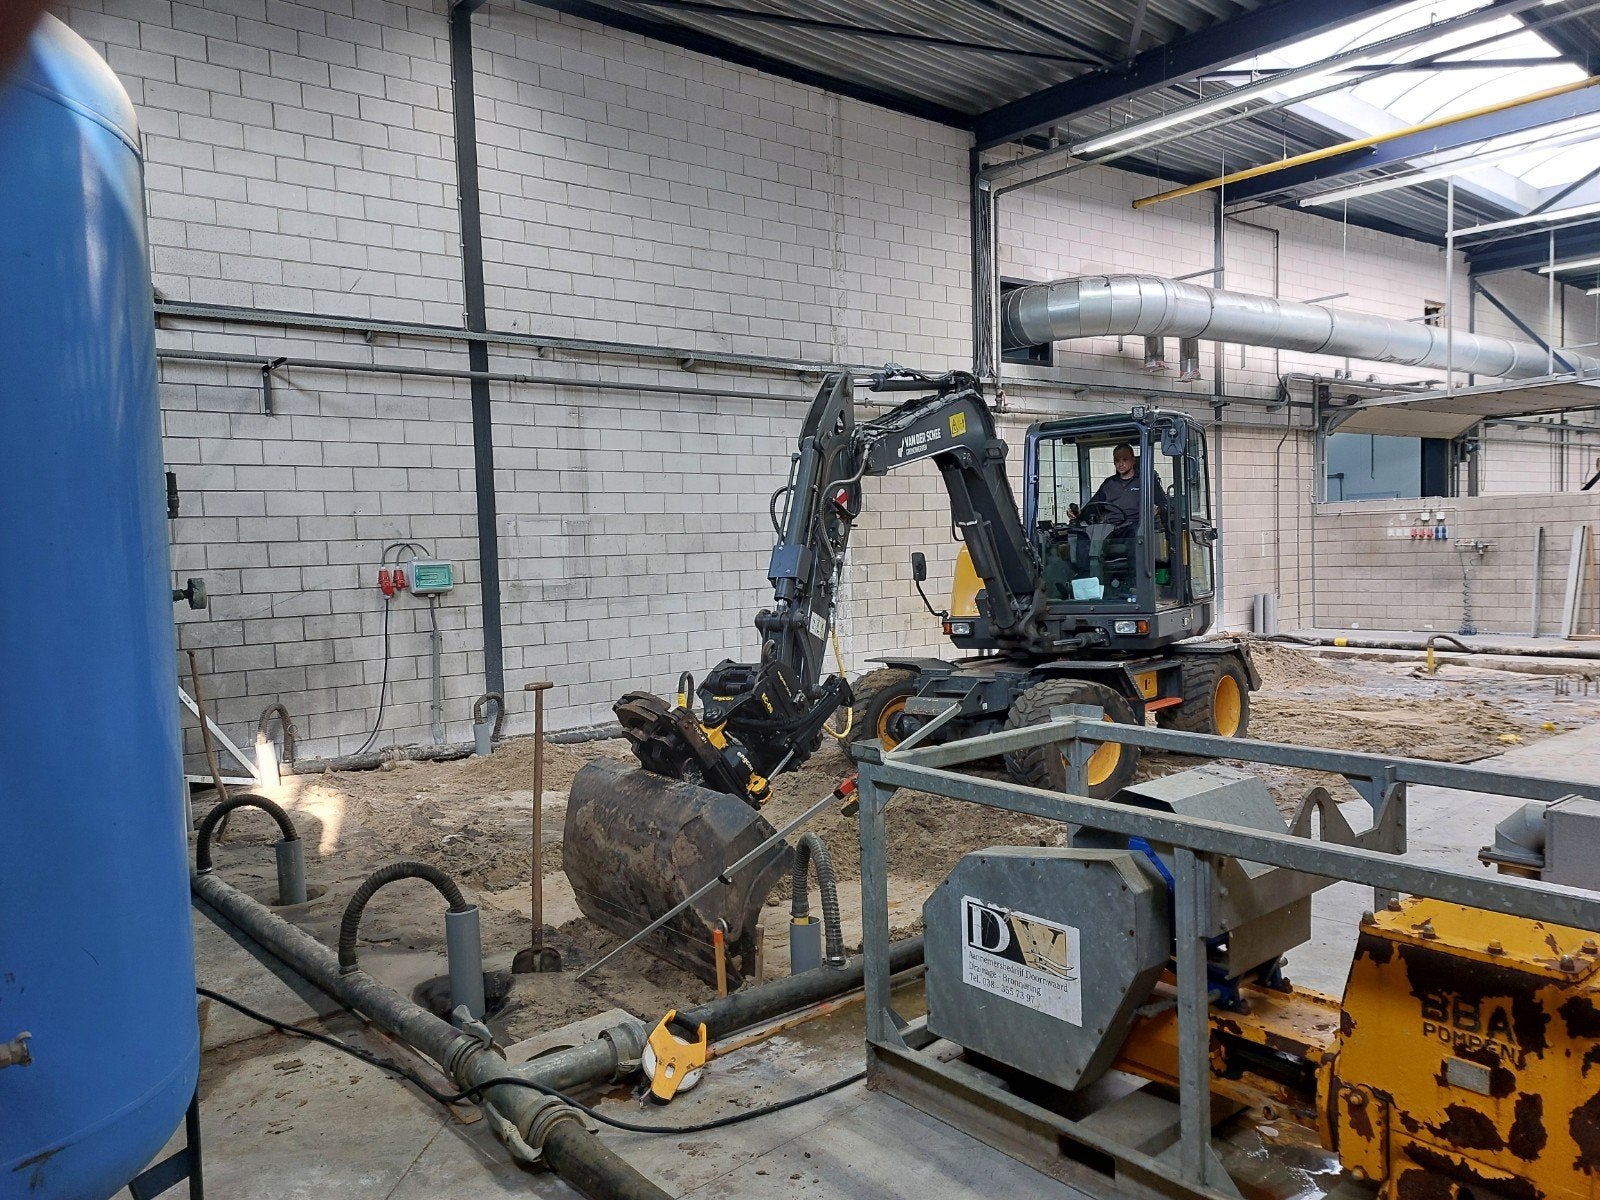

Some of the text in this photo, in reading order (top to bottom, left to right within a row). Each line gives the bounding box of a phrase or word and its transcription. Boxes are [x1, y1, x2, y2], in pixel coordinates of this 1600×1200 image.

[905, 435, 916, 447] VAN
[926, 428, 941, 441] SCHEE
[968, 960, 997, 979] Drainage
[969, 972, 980, 983] Tel.
[982, 978, 995, 988] 038
[1001, 984, 1014, 996] 355
[1015, 989, 1024, 999] 73
[1026, 994, 1035, 1004] 97
[1422, 1021, 1517, 1064] POMPEN
